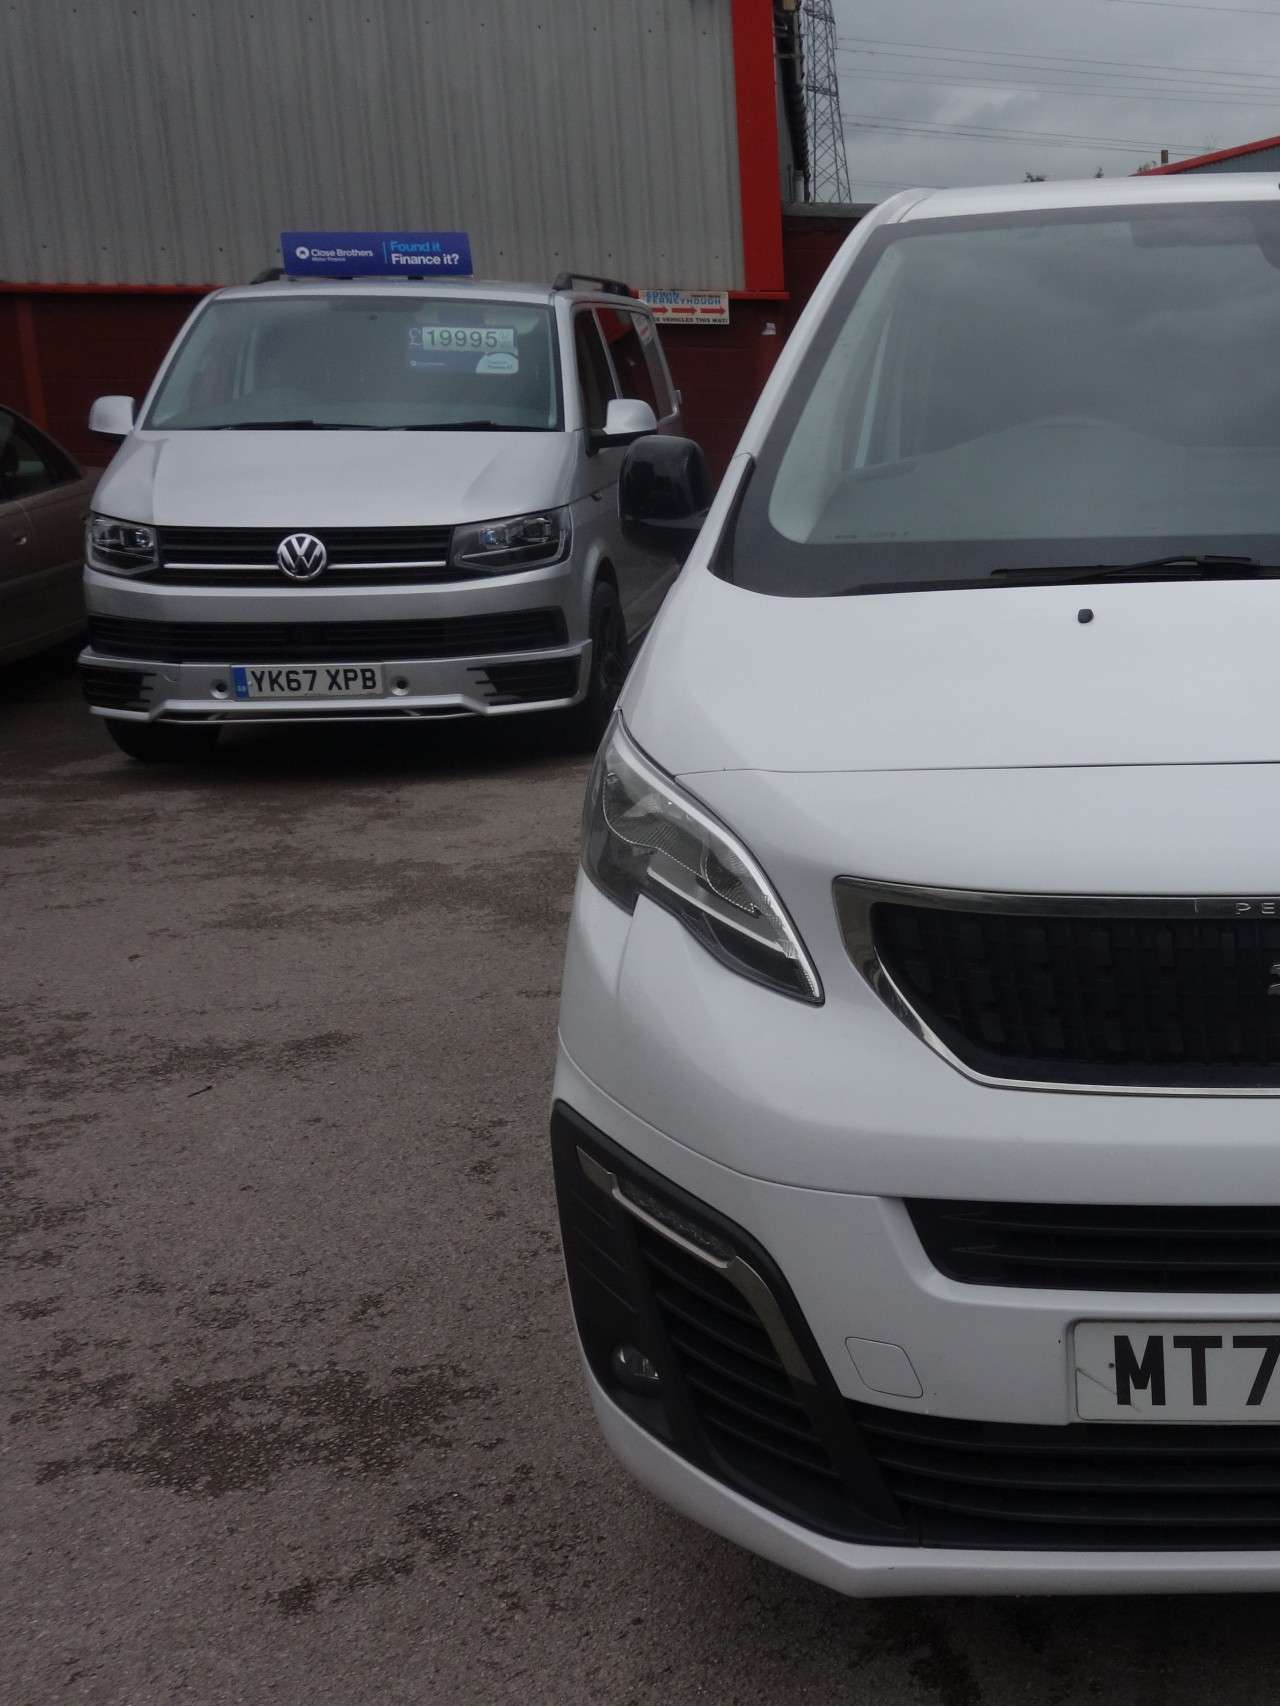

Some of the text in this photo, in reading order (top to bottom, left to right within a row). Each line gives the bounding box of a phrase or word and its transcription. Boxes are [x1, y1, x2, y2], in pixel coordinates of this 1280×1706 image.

[390, 240, 442, 252] Found it
[311, 248, 374, 257] Close Brothers
[391, 253, 460, 265] Finance it?
[251, 668, 377, 693] YK67 XPB
